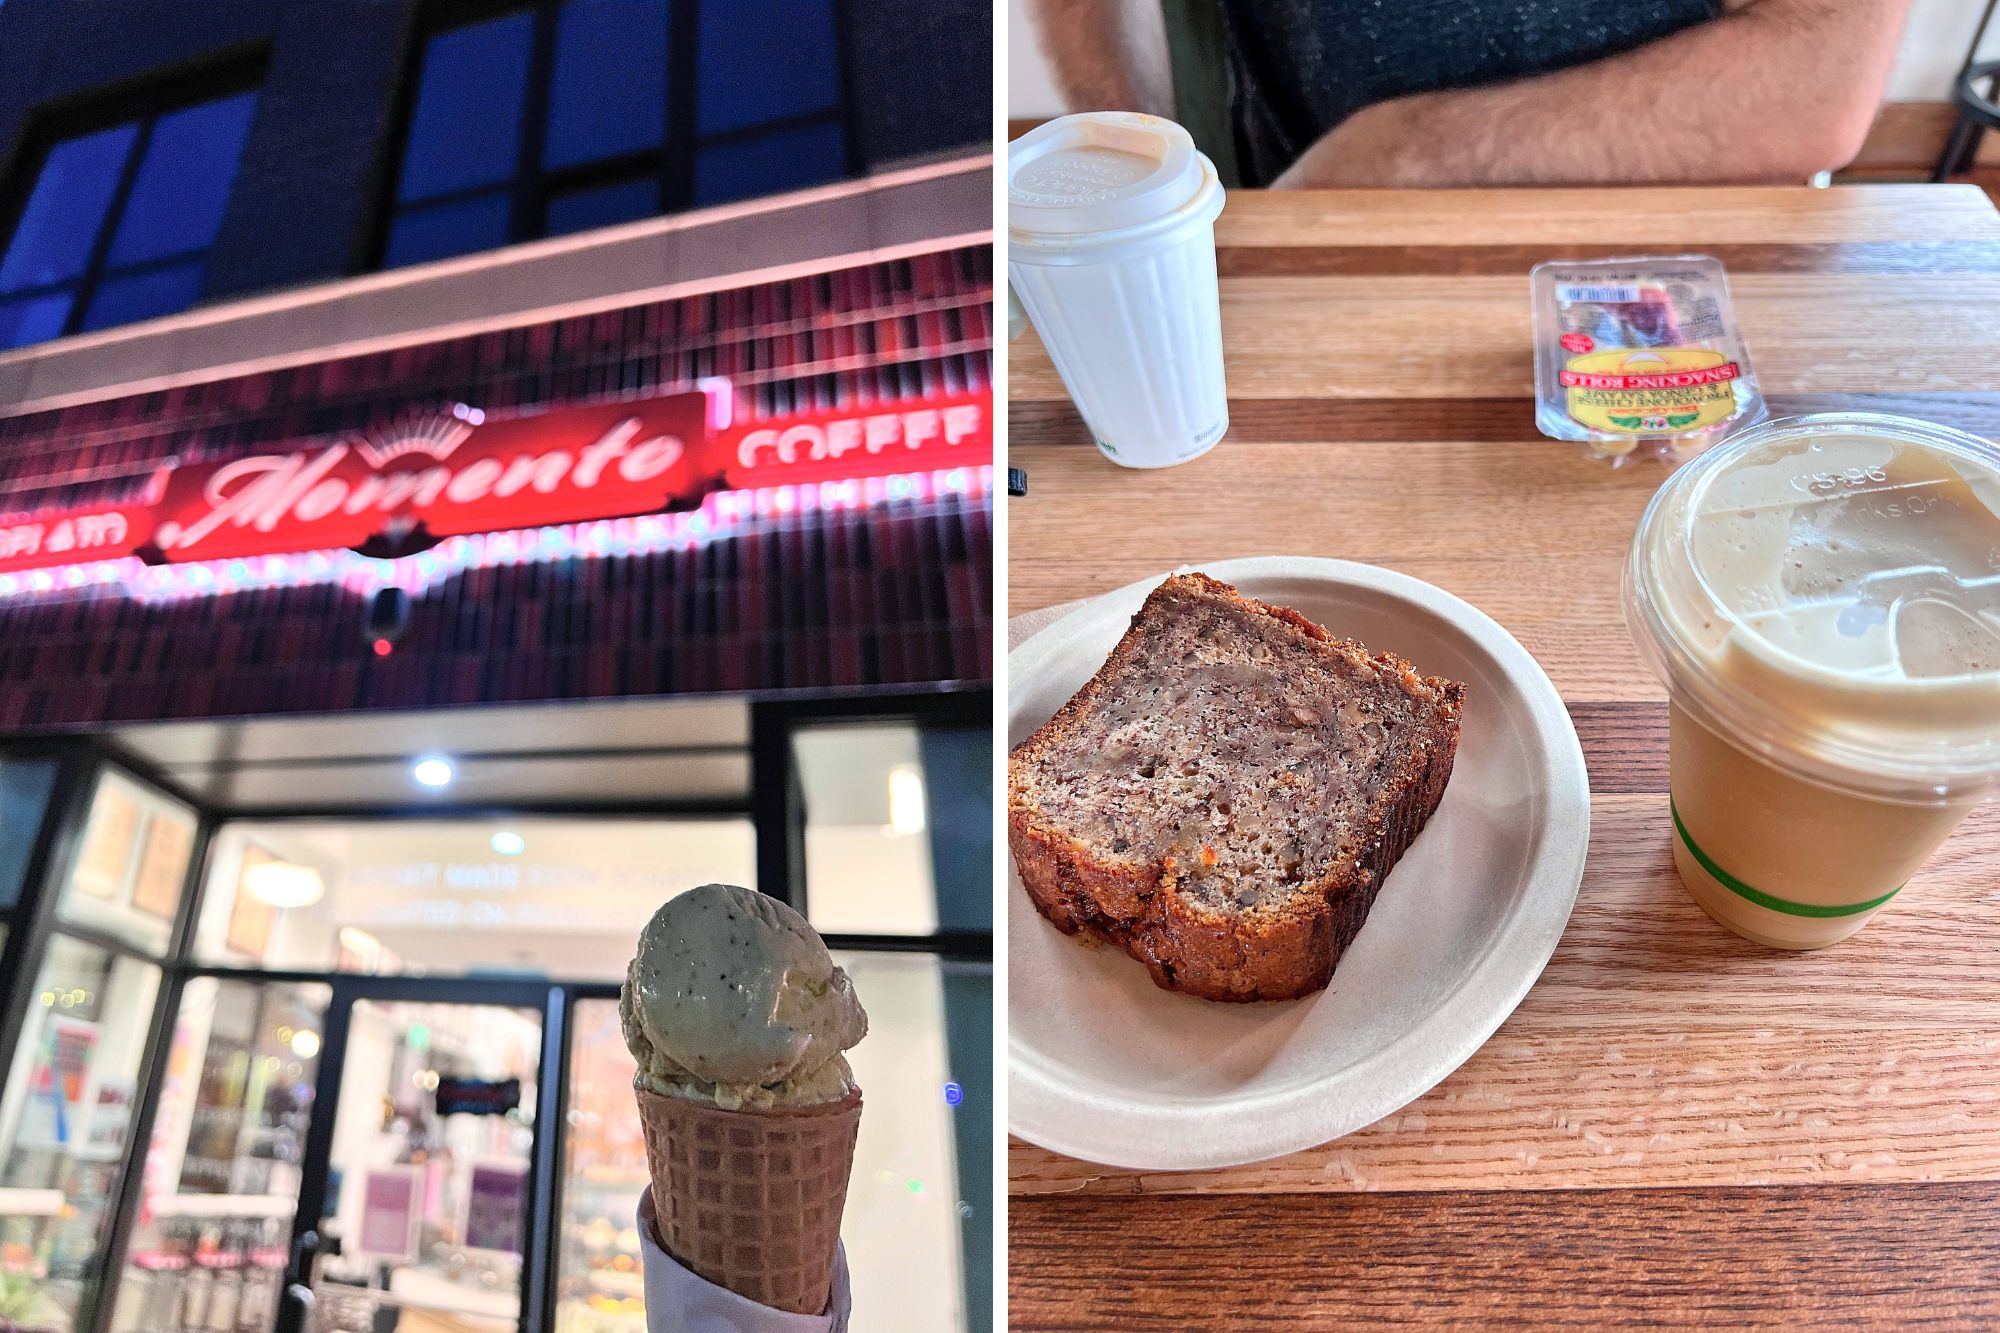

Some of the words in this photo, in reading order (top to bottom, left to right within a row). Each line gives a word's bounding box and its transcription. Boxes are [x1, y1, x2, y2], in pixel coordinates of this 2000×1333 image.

[1564, 374, 1624, 389] ROLLS
[1630, 366, 1733, 390] SNACKING
[1637, 391, 1731, 408] PROVOLONE
[1650, 386, 1703, 400] GENOA
[1575, 396, 1632, 408] CHEESE
[155, 416, 686, 549] Momento
